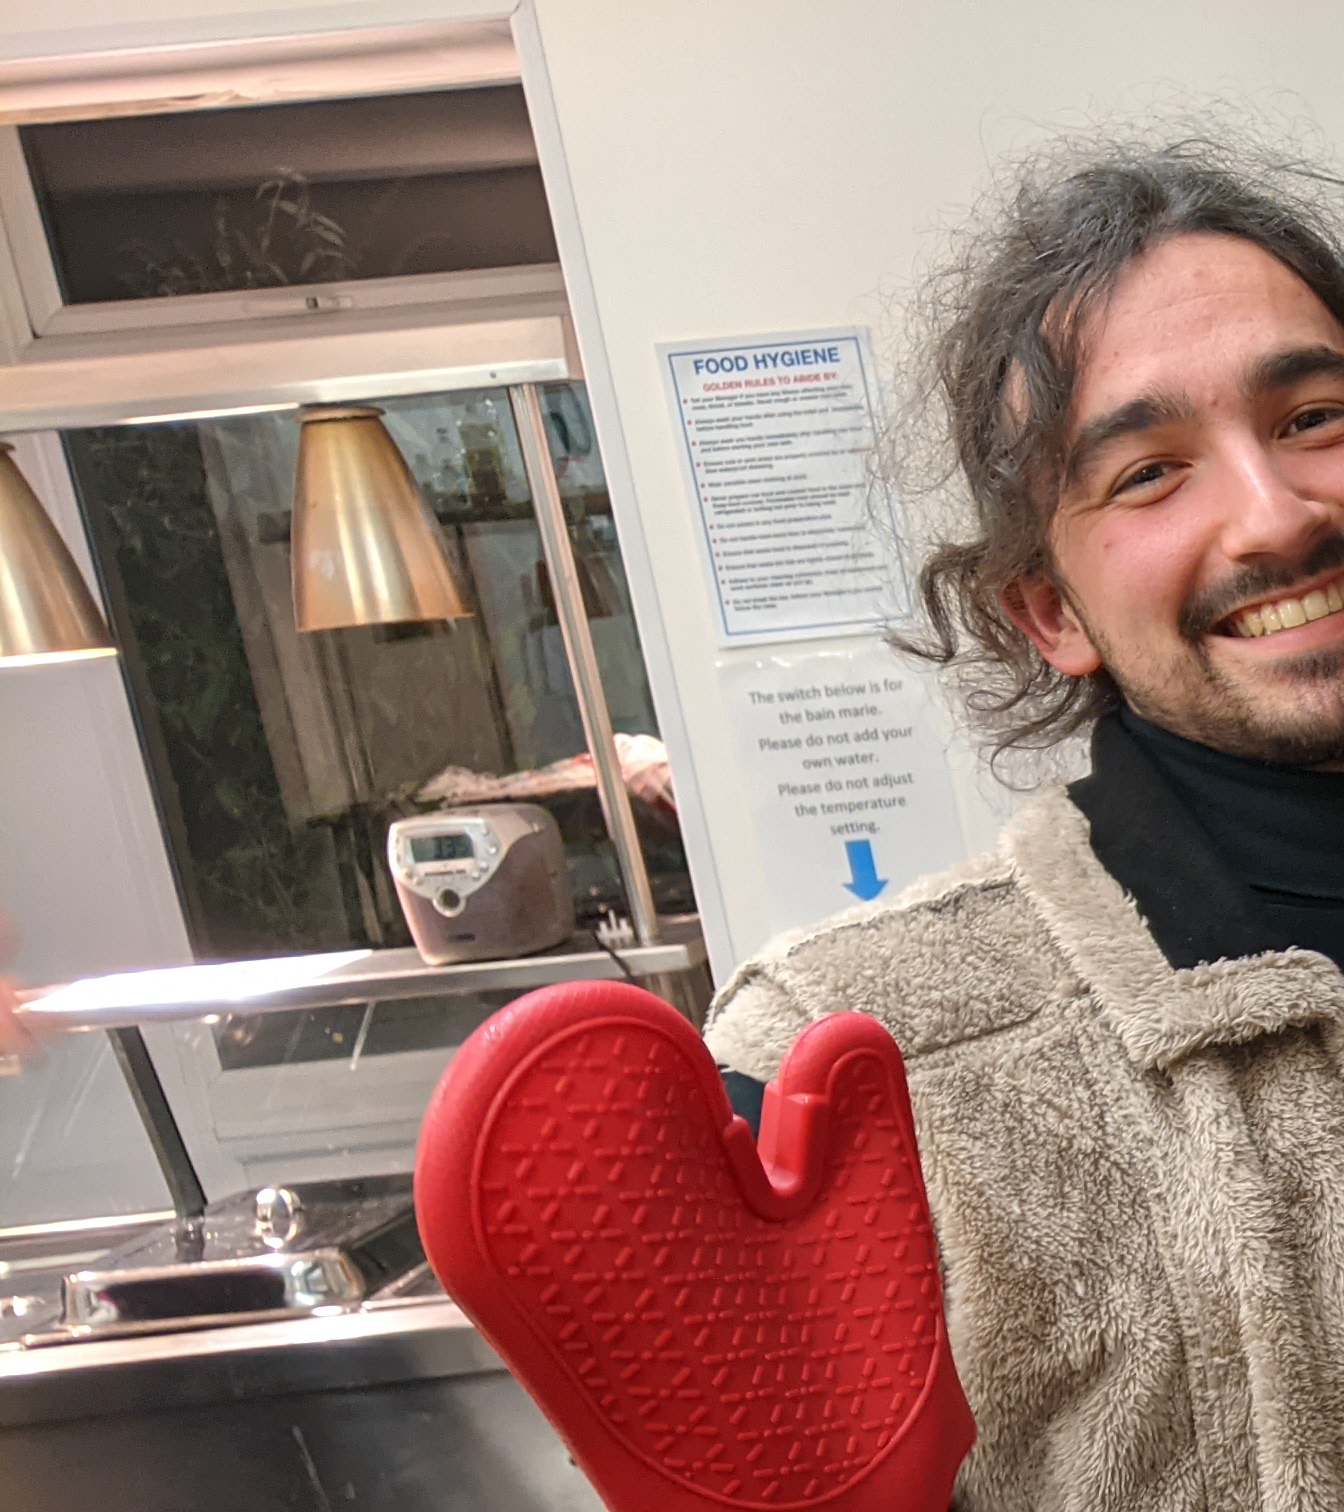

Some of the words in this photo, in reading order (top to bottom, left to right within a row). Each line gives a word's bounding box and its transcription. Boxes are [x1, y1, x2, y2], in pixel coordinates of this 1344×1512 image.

[694, 355, 748, 375] FOOD
[753, 347, 840, 369] HYGIENE
[703, 382, 742, 392] GOLDEN
[744, 377, 775, 388] RULES
[793, 374, 821, 383] ABIDE
[750, 691, 774, 705] The
[777, 686, 821, 702] switch
[825, 683, 865, 698] below
[869, 681, 881, 694] is
[883, 678, 903, 692] for
[779, 712, 802, 724] the
[806, 708, 835, 722] bain
[839, 704, 882, 718] marie.
[759, 736, 802, 751] Please
[806, 734, 823, 747] do
[827, 731, 851, 744] not
[854, 728, 878, 742] add
[882, 726, 912, 742] your
[802, 756, 832, 769] own
[836, 752, 879, 765] water.
[778, 782, 821, 797] Please
[825, 779, 842, 792] do
[846, 776, 869, 789] not
[873, 772, 913, 788] adjust
[795, 803, 817, 817] the
[821, 795, 907, 814] temperature
[831, 820, 880, 836] setting.
